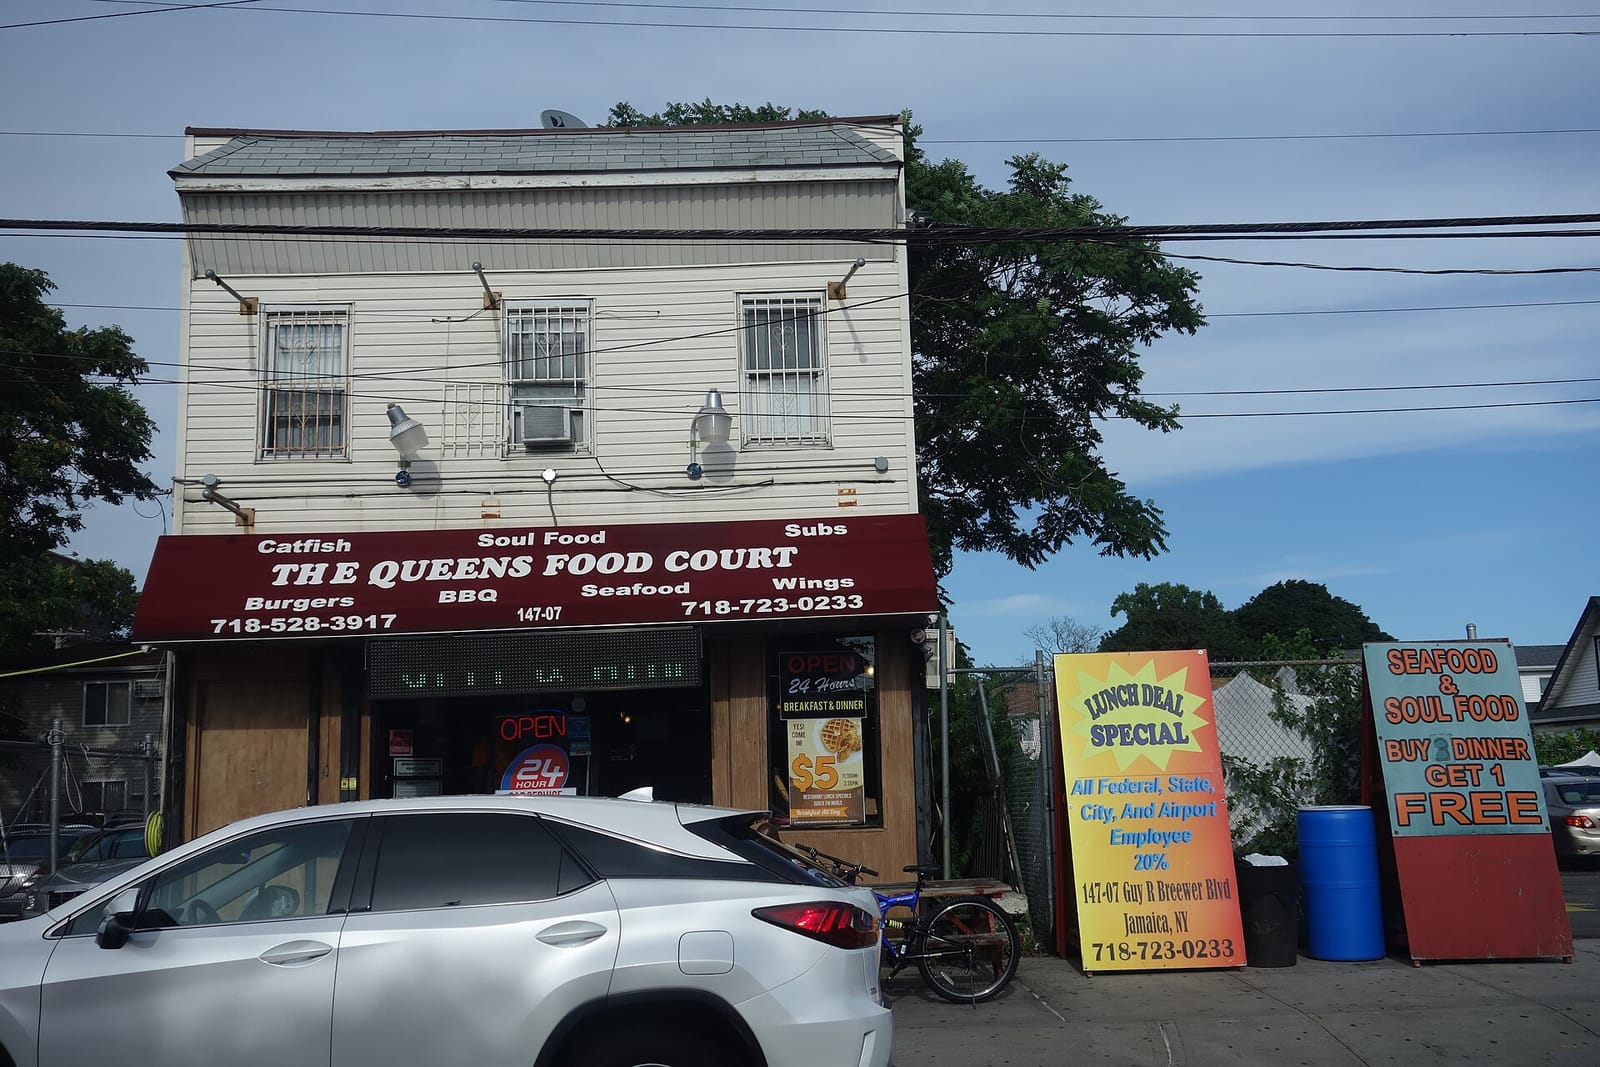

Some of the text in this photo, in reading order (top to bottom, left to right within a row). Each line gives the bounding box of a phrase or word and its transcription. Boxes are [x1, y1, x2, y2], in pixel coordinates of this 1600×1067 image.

[477, 530, 606, 548] Soul Food
[784, 523, 848, 538] Subs
[257, 538, 351, 554] Catfish
[271, 546, 798, 589] THE QUEENS FOOD COURT
[580, 582, 690, 598] Seafood
[772, 576, 855, 592] Wings
[244, 594, 355, 612] Burgers
[438, 588, 498, 605] BBQ
[681, 594, 864, 616] 718-723-0233
[210, 613, 397, 634] 718-528-3917
[516, 606, 562, 622] 147-07
[787, 655, 856, 673] OPEN
[1387, 648, 1498, 675] SEAFOOD
[788, 677, 856, 694] 24 Hours
[1439, 674, 1459, 695] &
[783, 700, 864, 712] BREAKFAST & DINNER
[1084, 683, 1184, 720] LUNCH DEAL
[1384, 695, 1519, 724] SOUL FOOD
[500, 714, 567, 741] OPEN
[1090, 722, 1189, 747] SPECIAL
[1384, 737, 1531, 762] BUY DINNER
[516, 758, 564, 787] 24
[791, 753, 839, 792] $5
[1424, 763, 1505, 788] GET 1
[515, 780, 547, 789] HOUR
[1071, 776, 1215, 796] All Federal, State,
[1080, 800, 1217, 824] City, And Airport
[1395, 791, 1543, 826] FREE
[1110, 828, 1192, 847] Employee
[1134, 853, 1169, 871] 20%
[1082, 878, 1231, 906] 147-07 Guy R Breewer Blvd
[1123, 911, 1188, 937] Jamaica, NY
[1092, 940, 1234, 961] 718-723-0233
